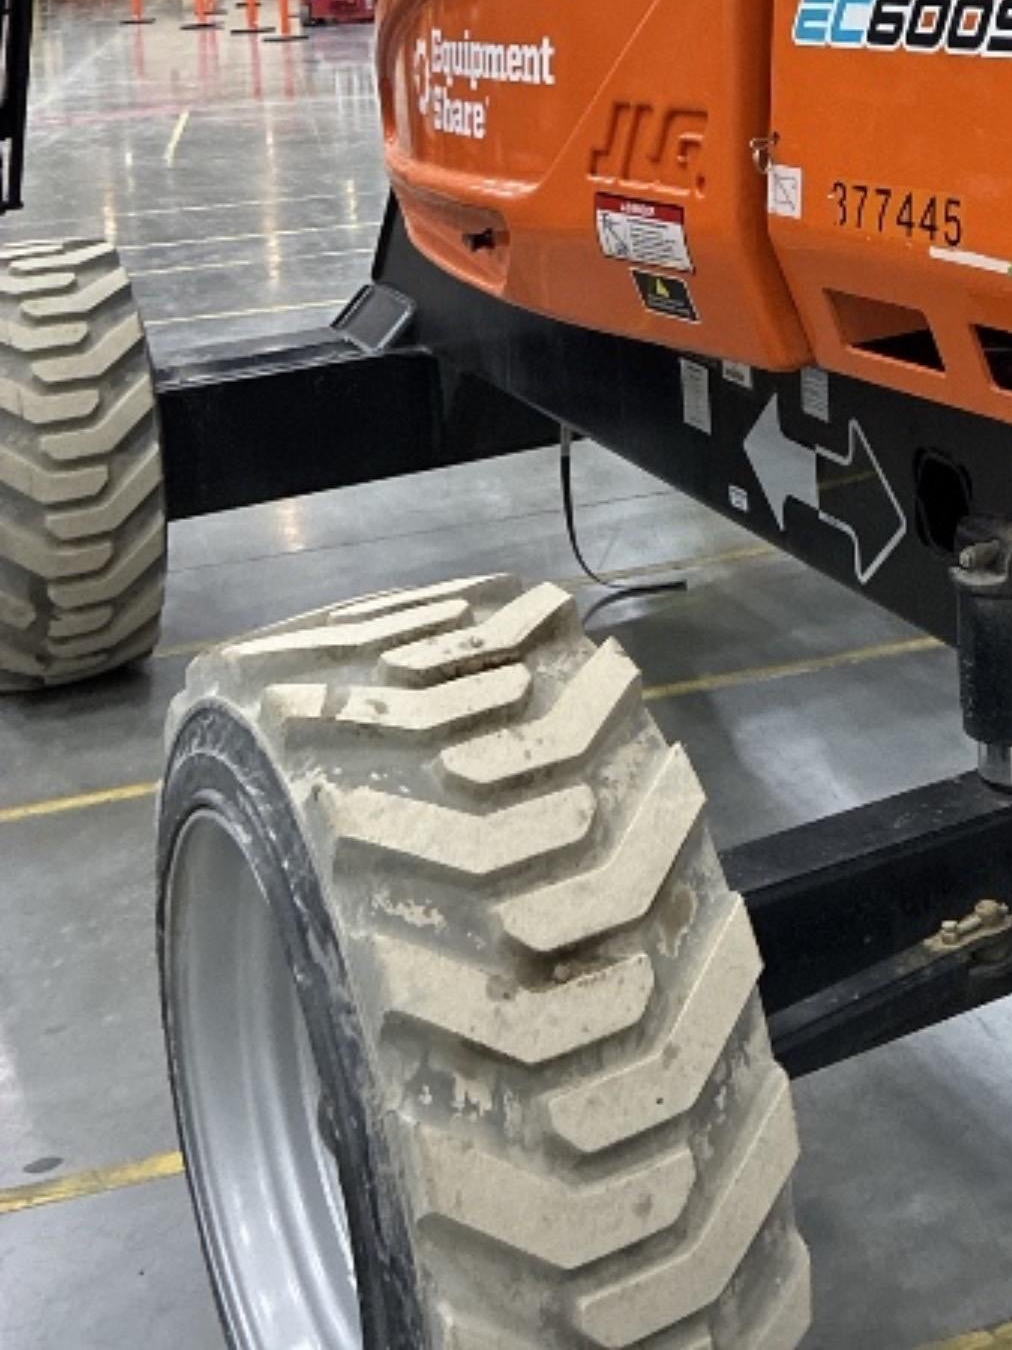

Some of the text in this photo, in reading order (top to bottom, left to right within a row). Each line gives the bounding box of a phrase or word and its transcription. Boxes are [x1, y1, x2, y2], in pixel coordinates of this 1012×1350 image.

[430, 27, 556, 90] Equipment
[432, 87, 487, 140] Share
[586, 101, 708, 196] JLG
[829, 180, 964, 247] 377445
